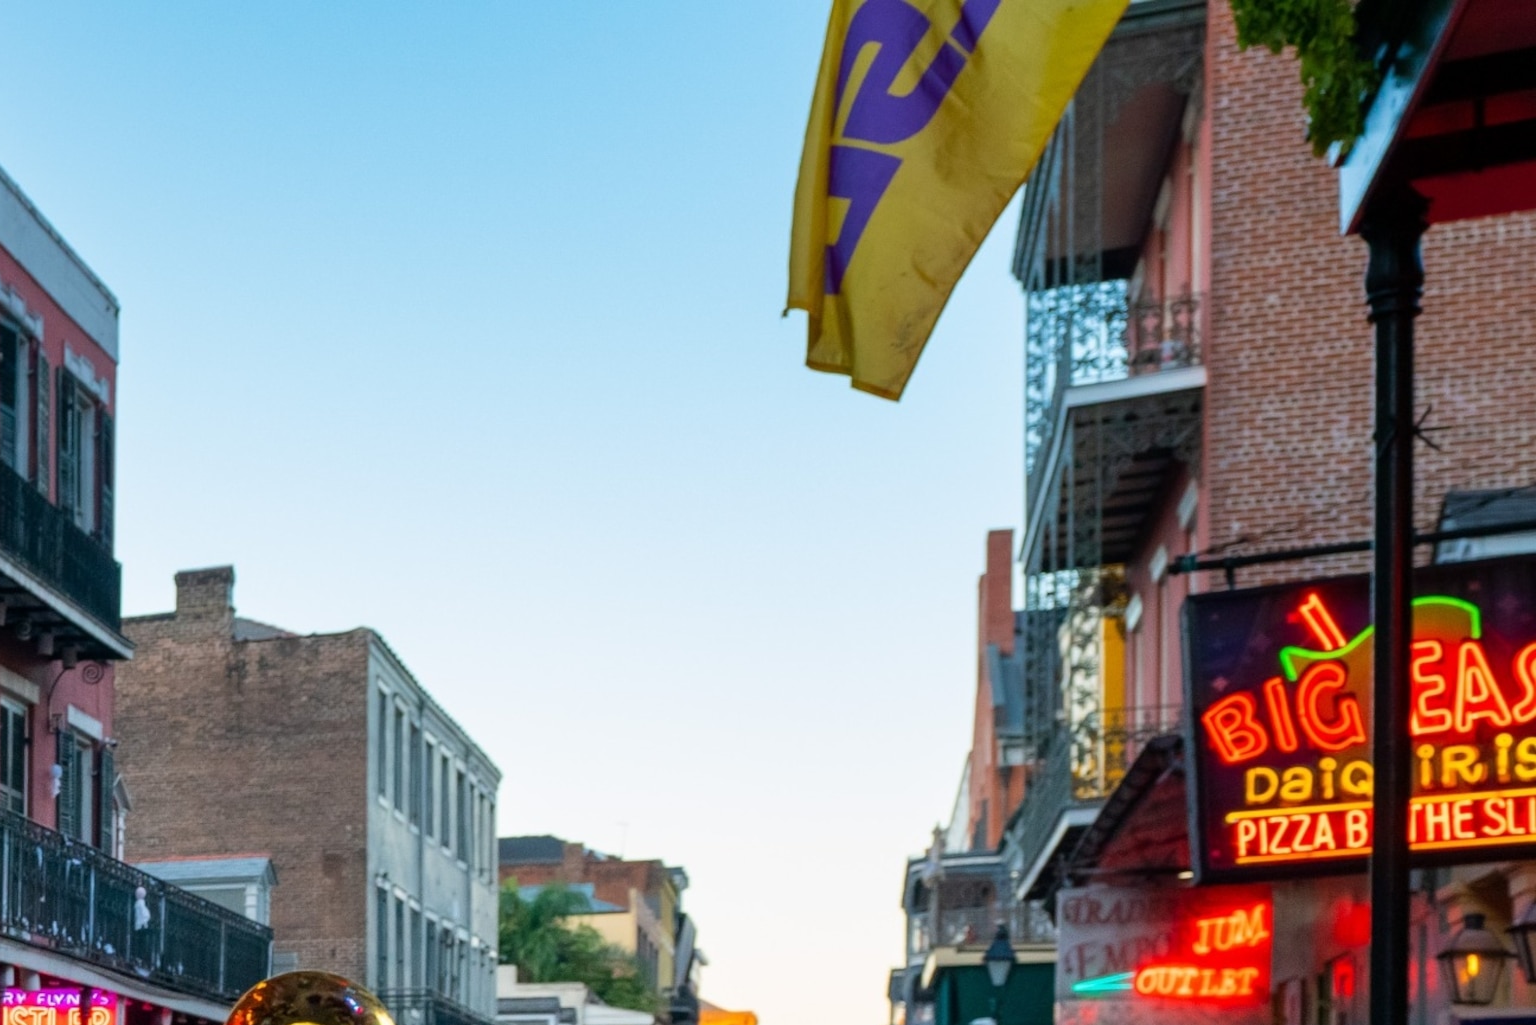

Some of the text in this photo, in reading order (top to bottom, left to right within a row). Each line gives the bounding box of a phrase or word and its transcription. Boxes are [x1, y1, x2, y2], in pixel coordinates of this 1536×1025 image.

[1201, 661, 1366, 765] BIG
[1236, 812, 1336, 857] PIZZA
[1346, 809, 1373, 849] B
[1409, 799, 1476, 843] THE
[1135, 965, 1259, 997] OUTLET
